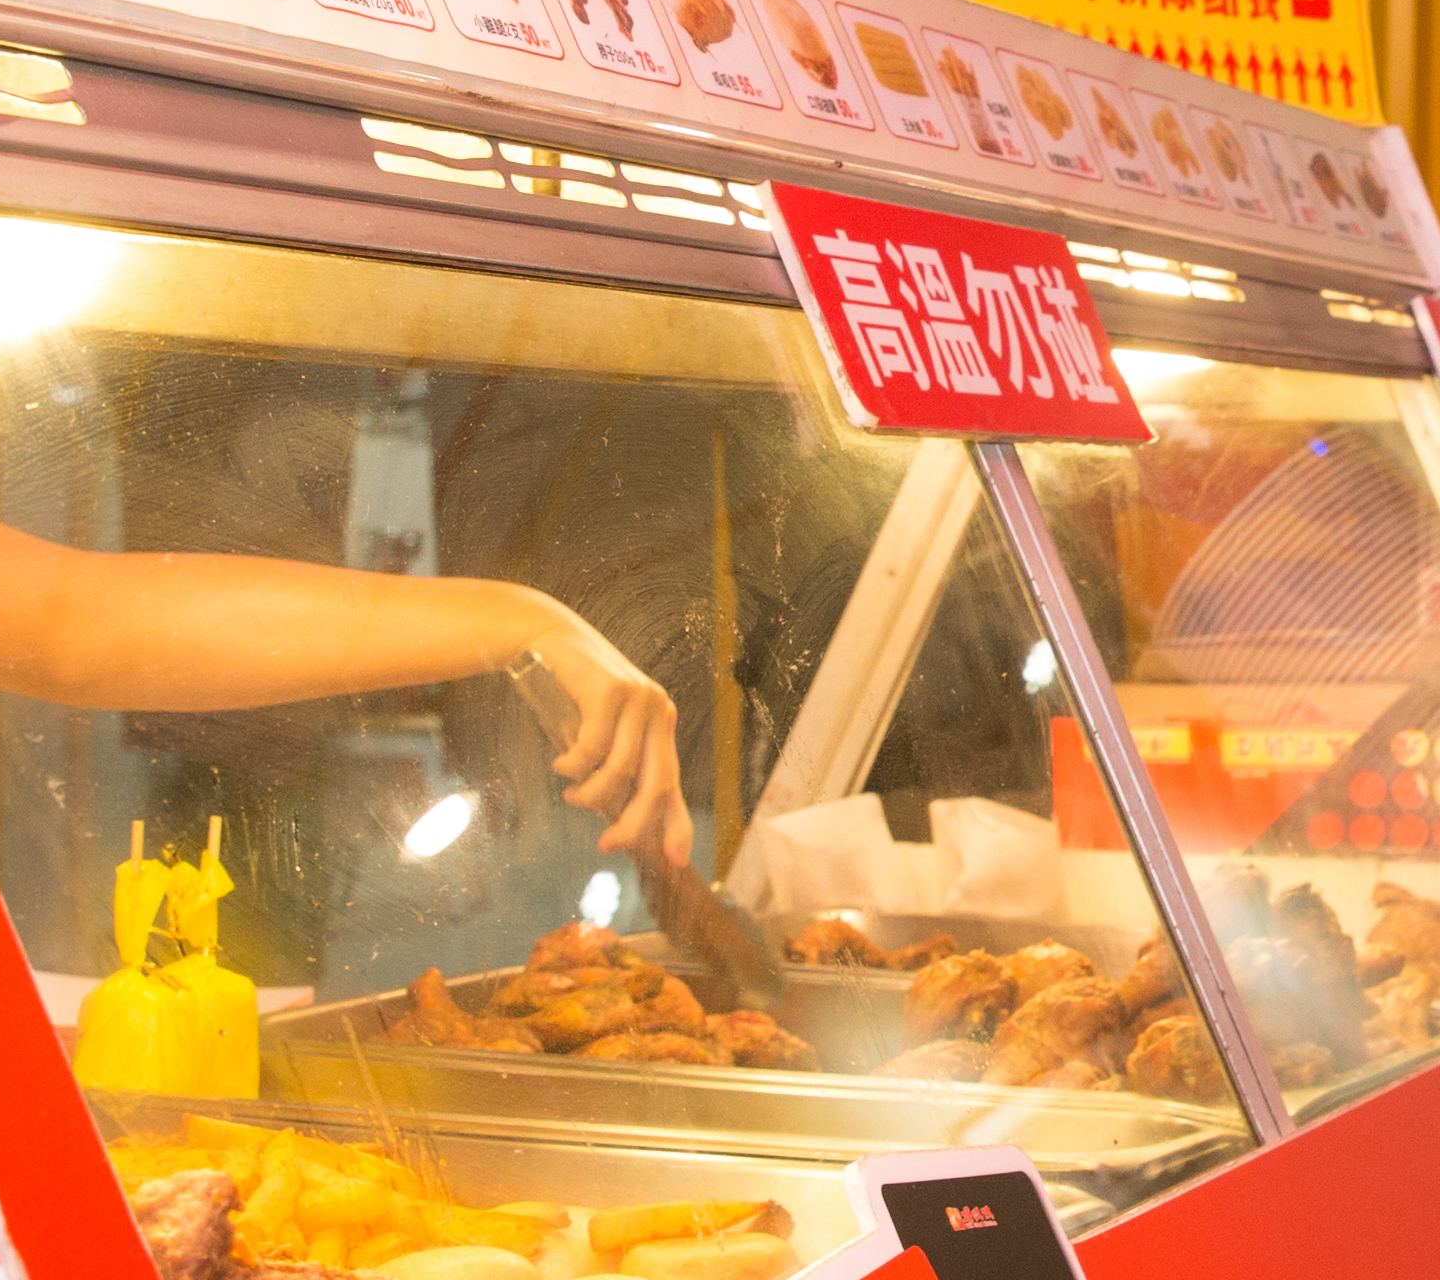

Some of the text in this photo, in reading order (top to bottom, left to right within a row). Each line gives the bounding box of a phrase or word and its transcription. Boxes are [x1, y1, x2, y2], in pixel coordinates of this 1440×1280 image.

[518, 21, 541, 48] 50
[634, 49, 657, 73] 76
[812, 229, 1120, 406] 高溫勿碰
